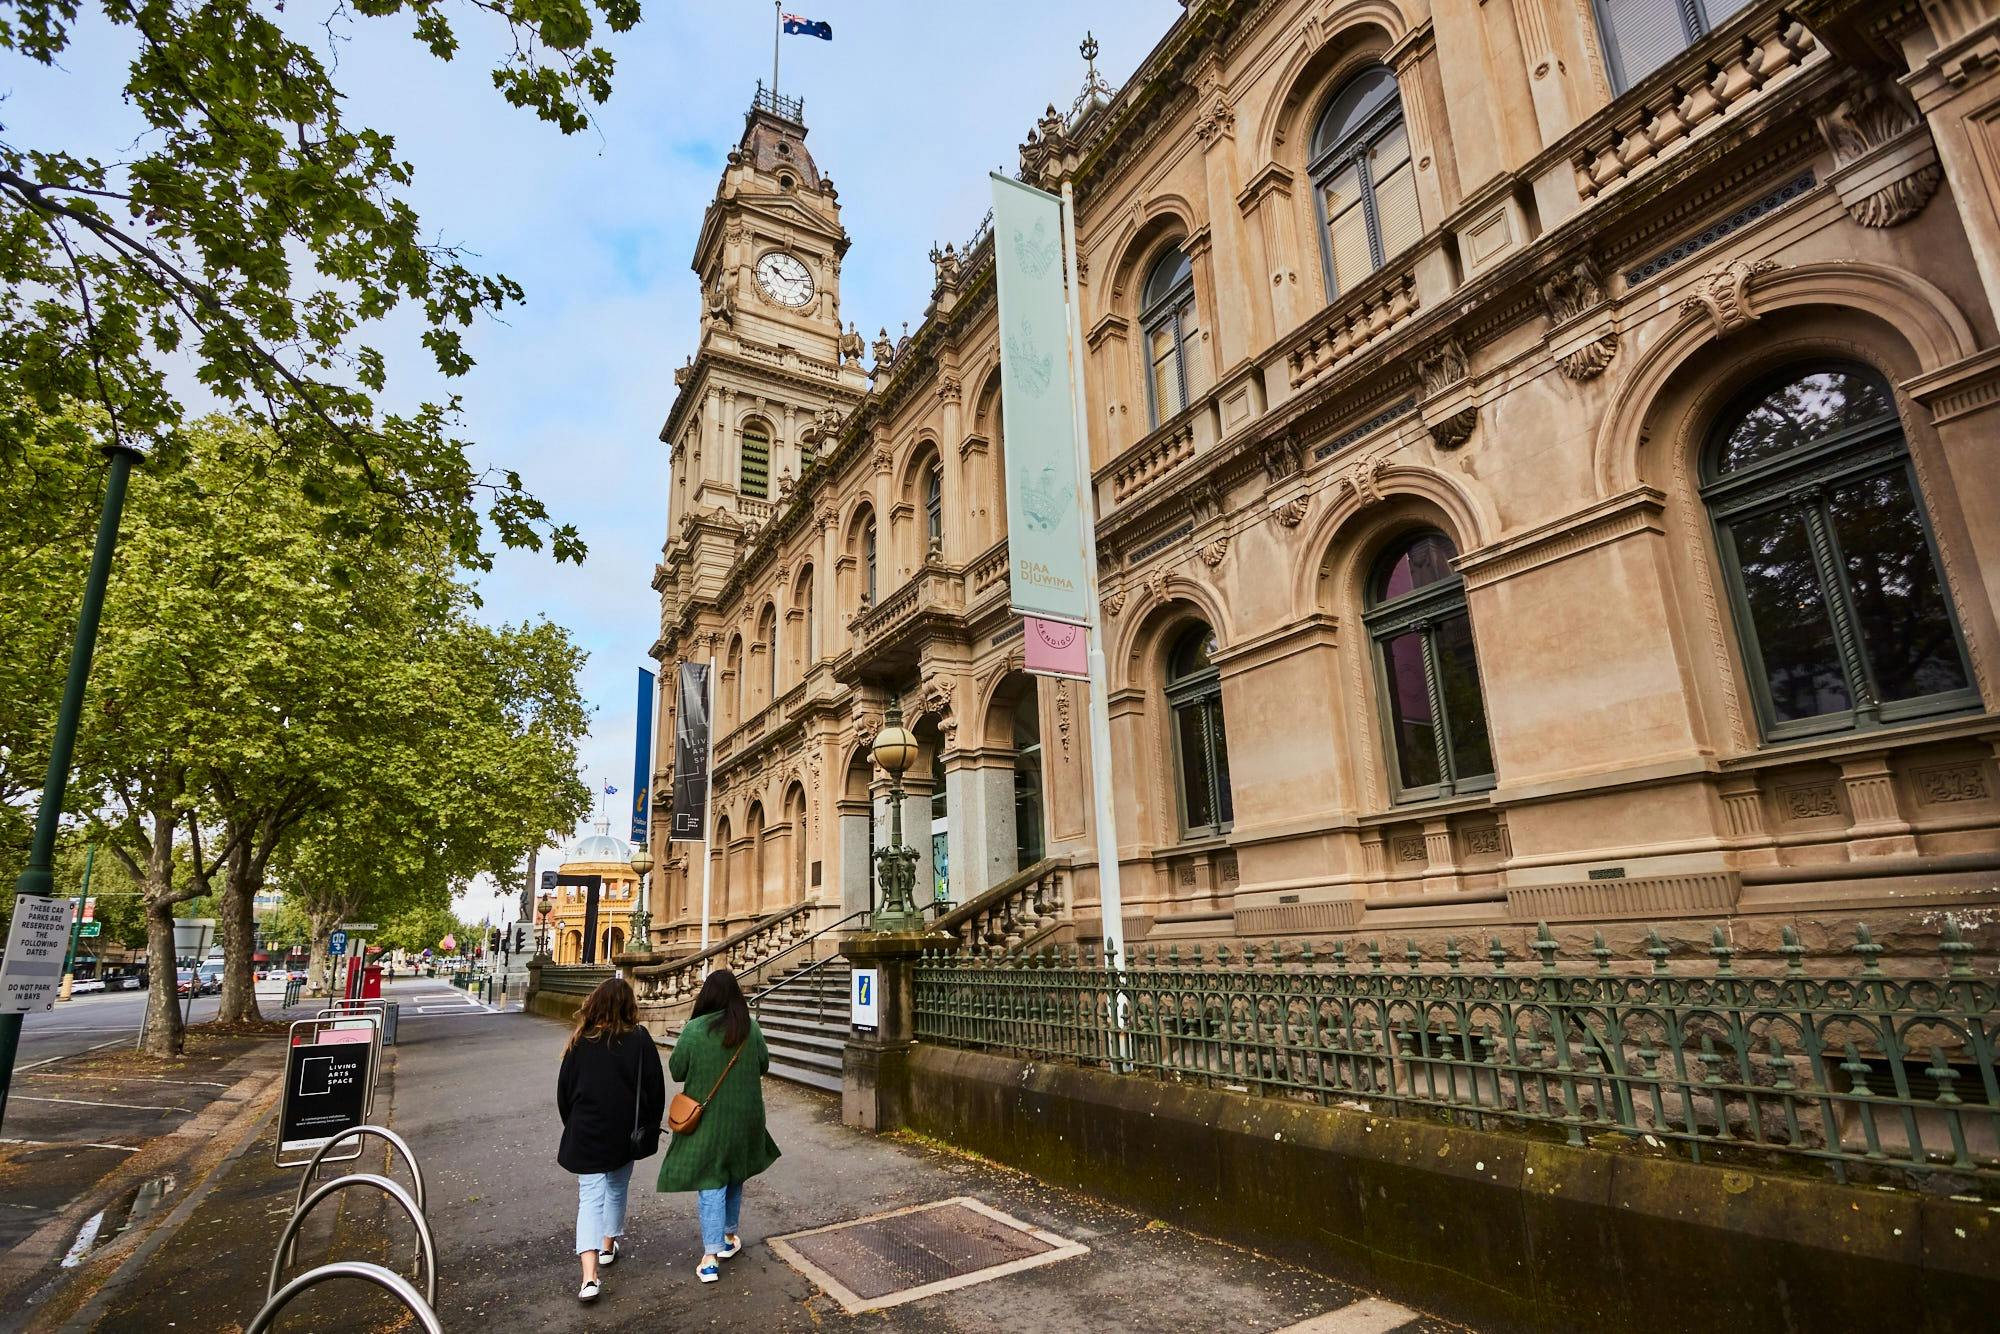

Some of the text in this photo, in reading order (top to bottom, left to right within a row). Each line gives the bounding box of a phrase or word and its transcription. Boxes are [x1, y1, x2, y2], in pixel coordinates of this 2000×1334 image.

[1038, 623, 1071, 646] BENDIGO
[691, 738, 706, 746] LIV
[692, 747, 704, 755] AR
[30, 904, 64, 914] THESE CAR
[28, 913, 49, 921] PARKS
[21, 921, 54, 930] RESERVED
[36, 931, 48, 939] THE
[20, 939, 58, 948] FOLLOWING
[329, 1063, 357, 1071] LIVING
[328, 1070, 349, 1078] ARTS
[328, 1077, 353, 1085] SPACE
